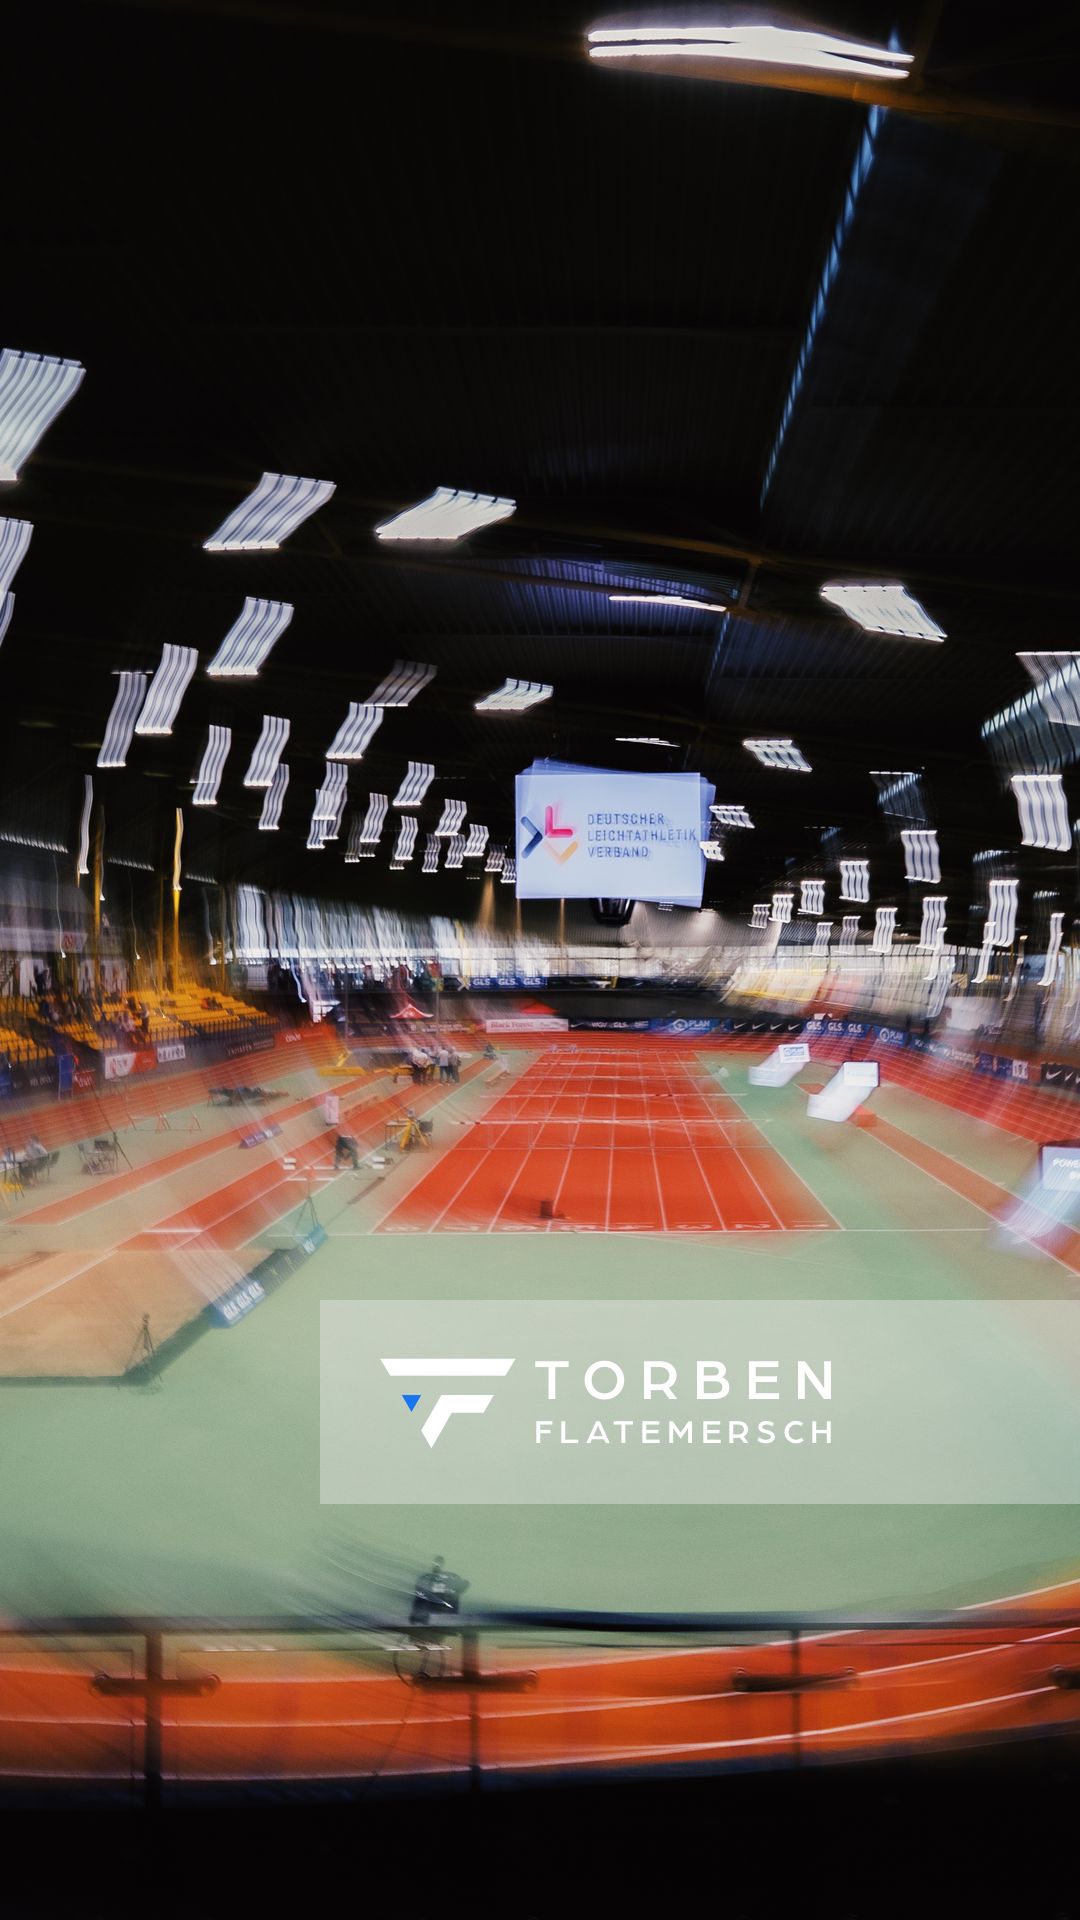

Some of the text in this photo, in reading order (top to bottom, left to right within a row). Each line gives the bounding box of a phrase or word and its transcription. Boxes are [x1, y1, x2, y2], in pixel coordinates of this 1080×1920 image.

[587, 813, 665, 826] DEUTSCHER
[587, 828, 697, 842] LEICHTATHLETIK
[587, 846, 649, 858] VERBAND
